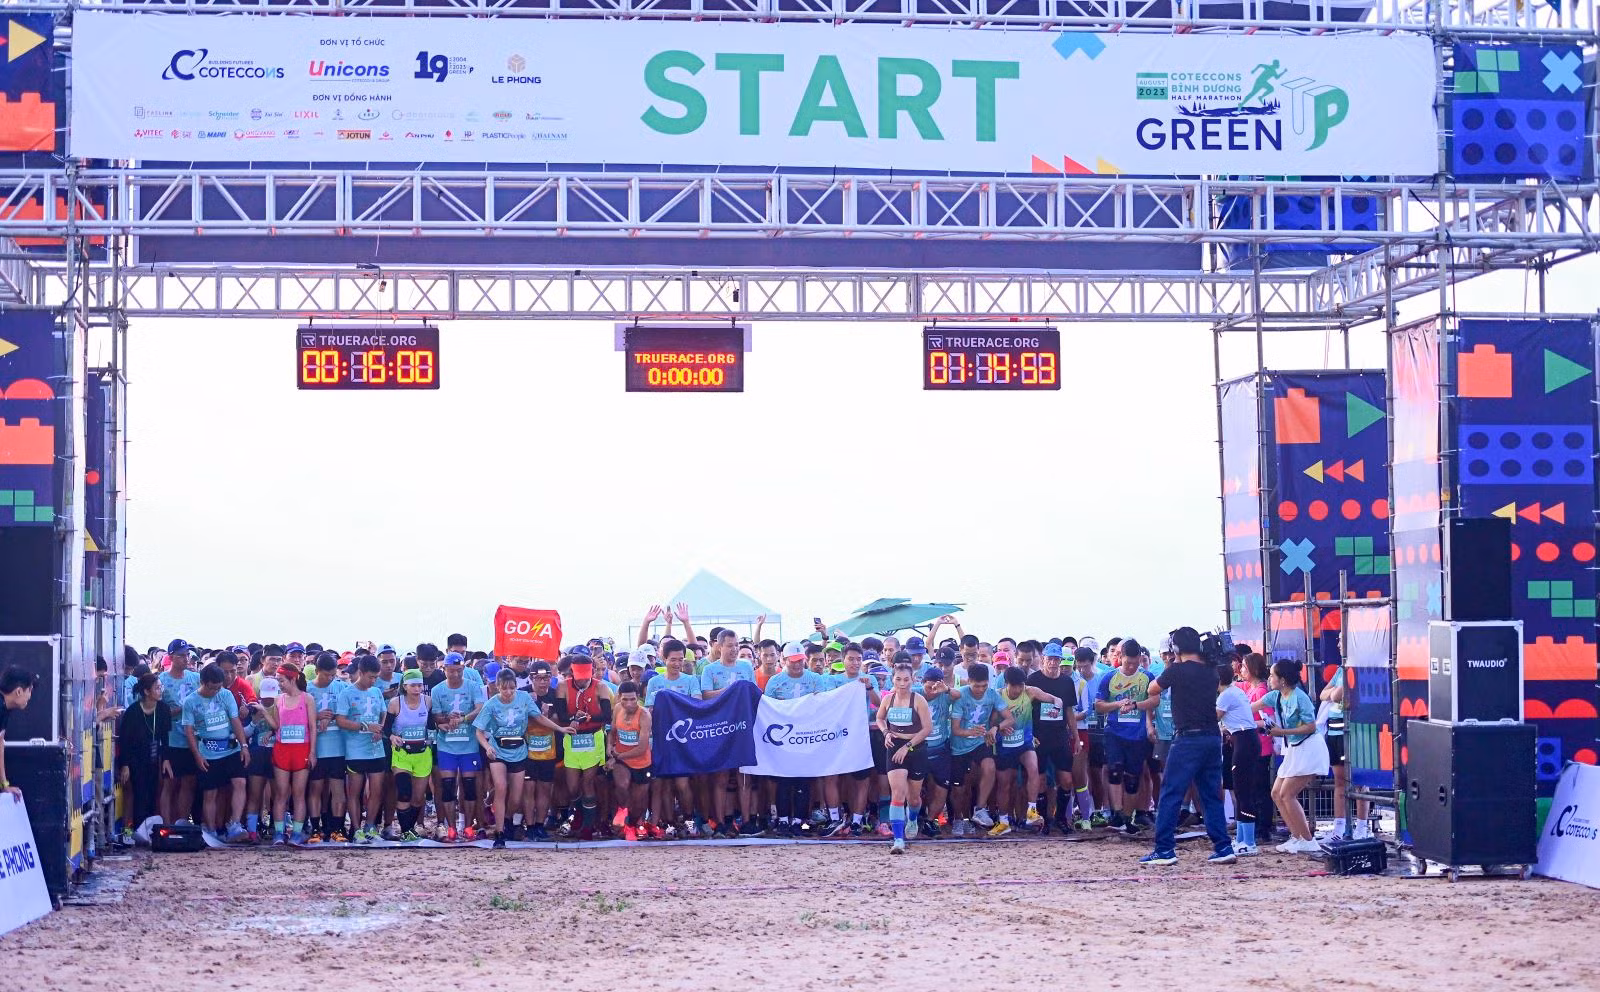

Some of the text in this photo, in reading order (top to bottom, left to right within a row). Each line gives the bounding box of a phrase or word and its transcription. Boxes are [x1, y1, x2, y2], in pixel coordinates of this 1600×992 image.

[309, 60, 390, 76] Unicons
[414, 51, 448, 82] 19
[1171, 72, 1242, 81] COTECCONS
[640, 50, 1019, 142] START
[1140, 88, 1165, 96] 2023
[1136, 118, 1282, 151] GREEN
[319, 335, 417, 346] TRUERACE.ORG
[946, 337, 1039, 348] TRUERACE.ORG
[634, 353, 735, 363] TRUERACE.ORG
[648, 367, 723, 385] 0:00:00
[690, 720, 746, 740] COTECCONS
[788, 728, 848, 745] COTECCONS
[3, 842, 35, 876] PHONG
